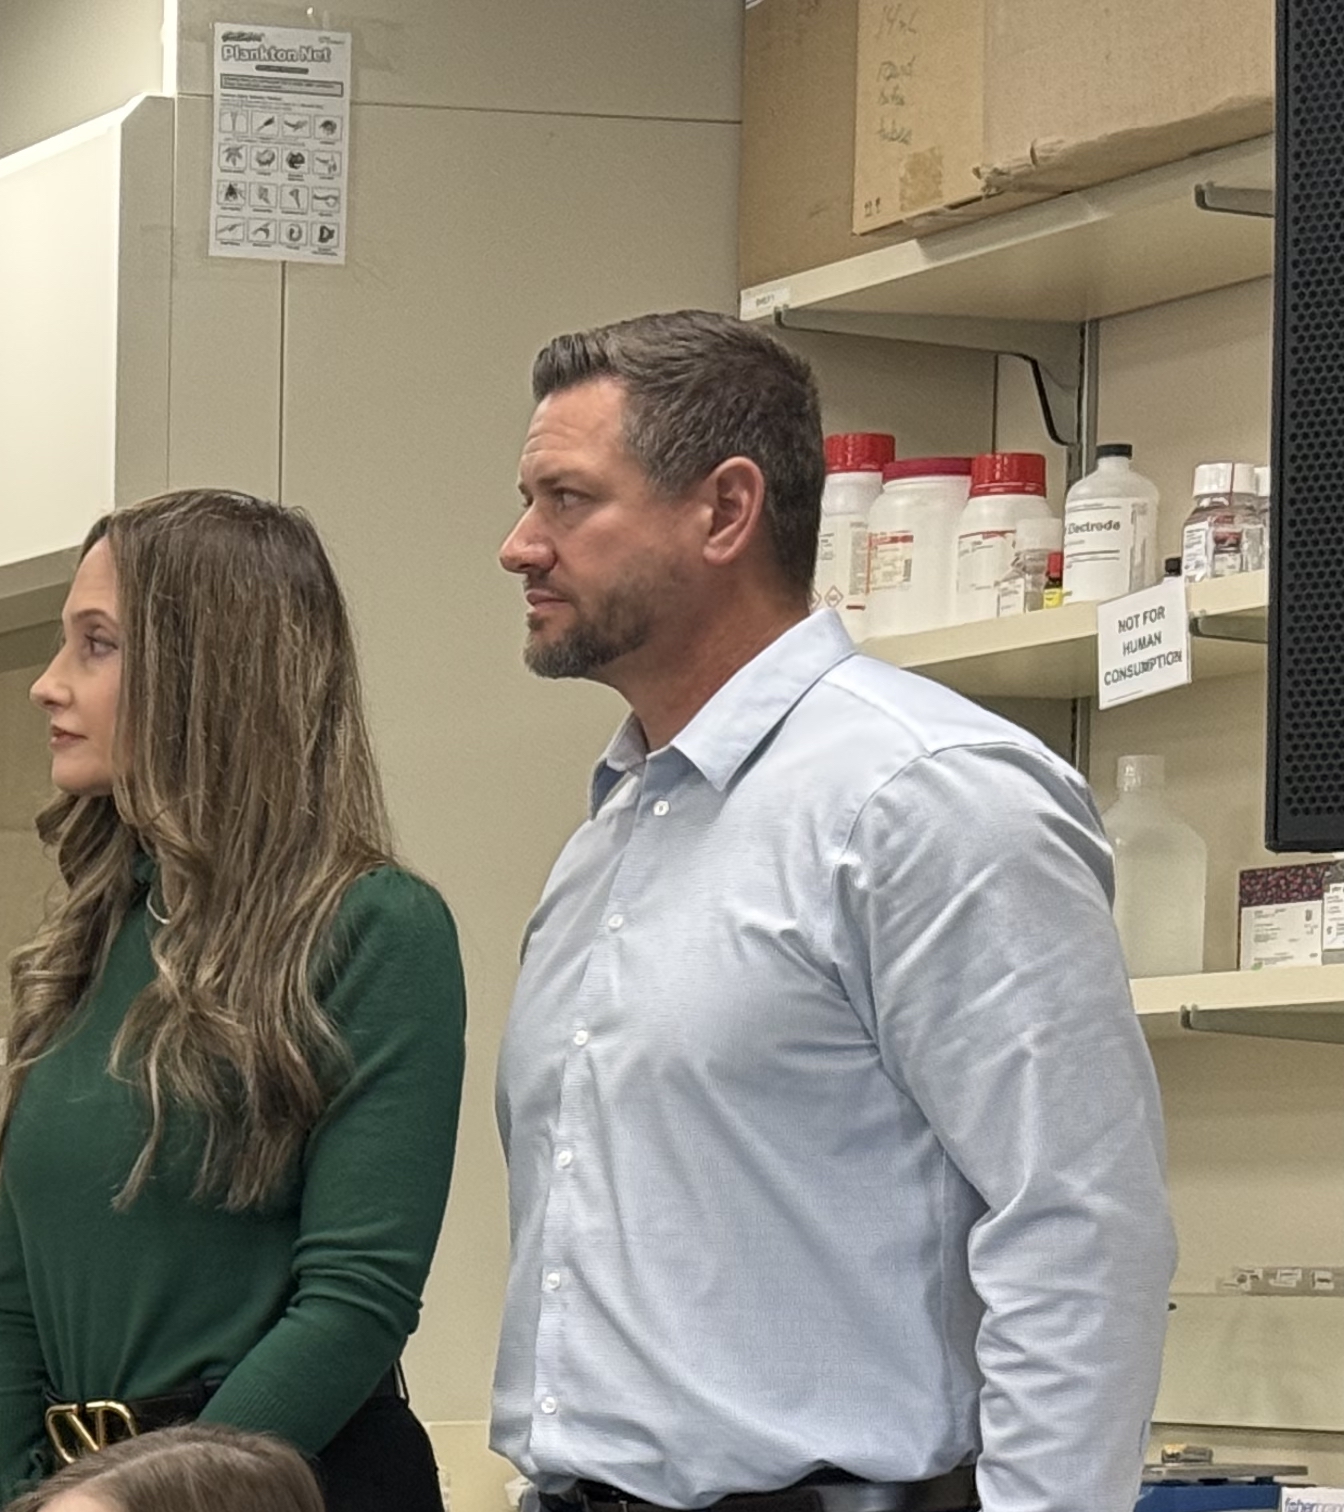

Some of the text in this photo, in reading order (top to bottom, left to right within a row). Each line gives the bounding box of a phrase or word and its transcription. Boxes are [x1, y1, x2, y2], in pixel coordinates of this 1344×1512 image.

[221, 44, 332, 63] Plankton Net
[1117, 605, 1166, 634] NOT FOR
[1122, 630, 1162, 657] HUMAN
[1103, 649, 1183, 686] CONSUMPTION
